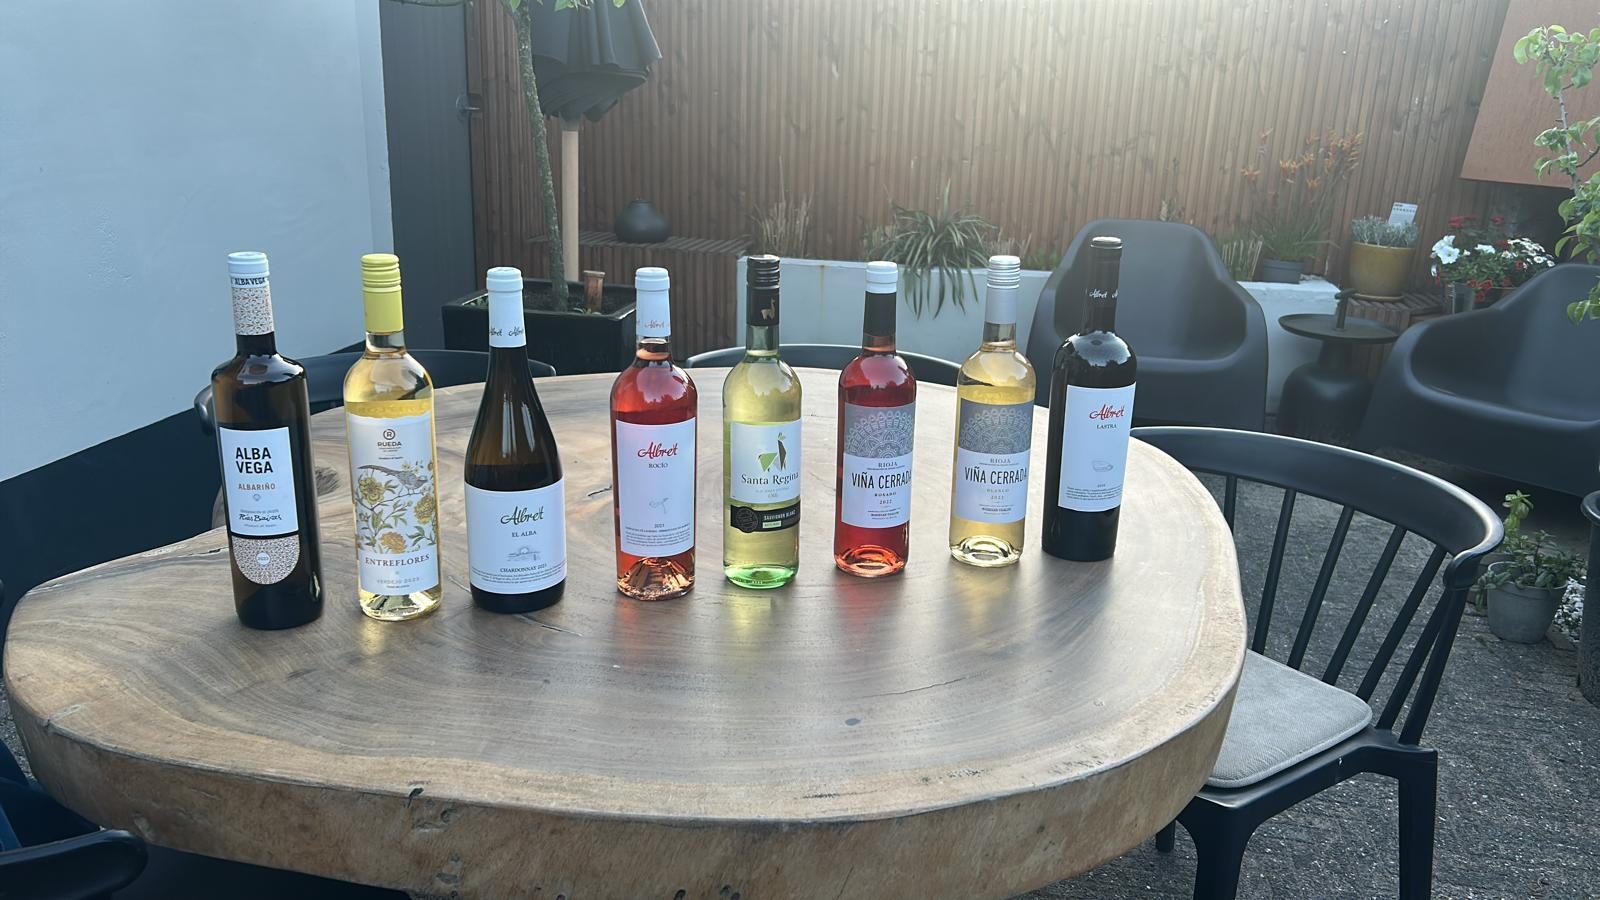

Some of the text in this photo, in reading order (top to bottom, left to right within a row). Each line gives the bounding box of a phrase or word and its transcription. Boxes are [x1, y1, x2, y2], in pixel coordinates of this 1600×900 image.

[1089, 404, 1125, 421] Albret
[235, 447, 272, 460] ALBA
[637, 441, 678, 459] Albret
[235, 461, 273, 474] VEGA
[964, 465, 987, 484] VIÑA
[741, 471, 799, 485] Santa Regina
[851, 471, 875, 489] VIÑA
[238, 482, 276, 491] ALBARIÑO
[500, 505, 544, 526] Albret
[520, 530, 537, 538] ALBA
[364, 553, 430, 567] ENTREFLORES
